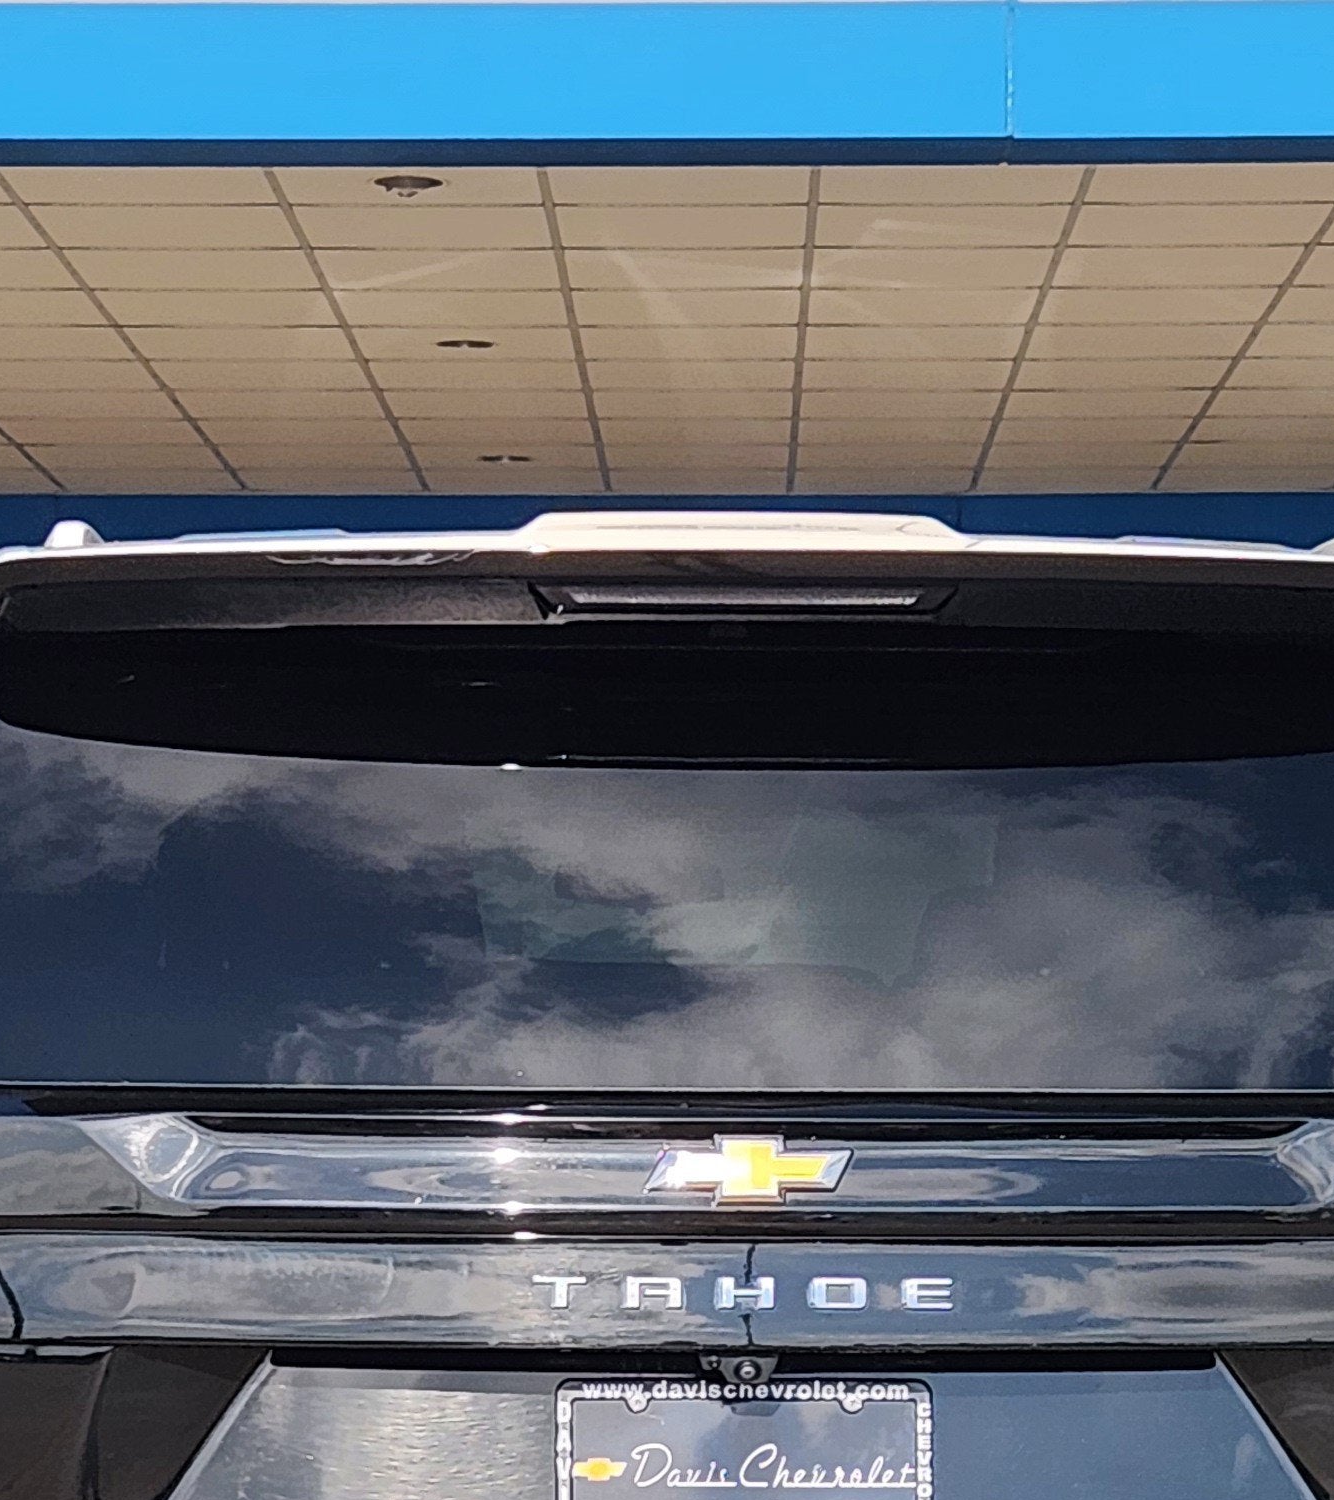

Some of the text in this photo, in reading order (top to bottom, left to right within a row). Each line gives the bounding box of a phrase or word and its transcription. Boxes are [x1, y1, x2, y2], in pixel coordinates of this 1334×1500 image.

[531, 1276, 954, 1311] TAHOE
[581, 1380, 910, 1400] www.davischevrolet.com
[630, 1443, 917, 1488] Davis Chevrolet
